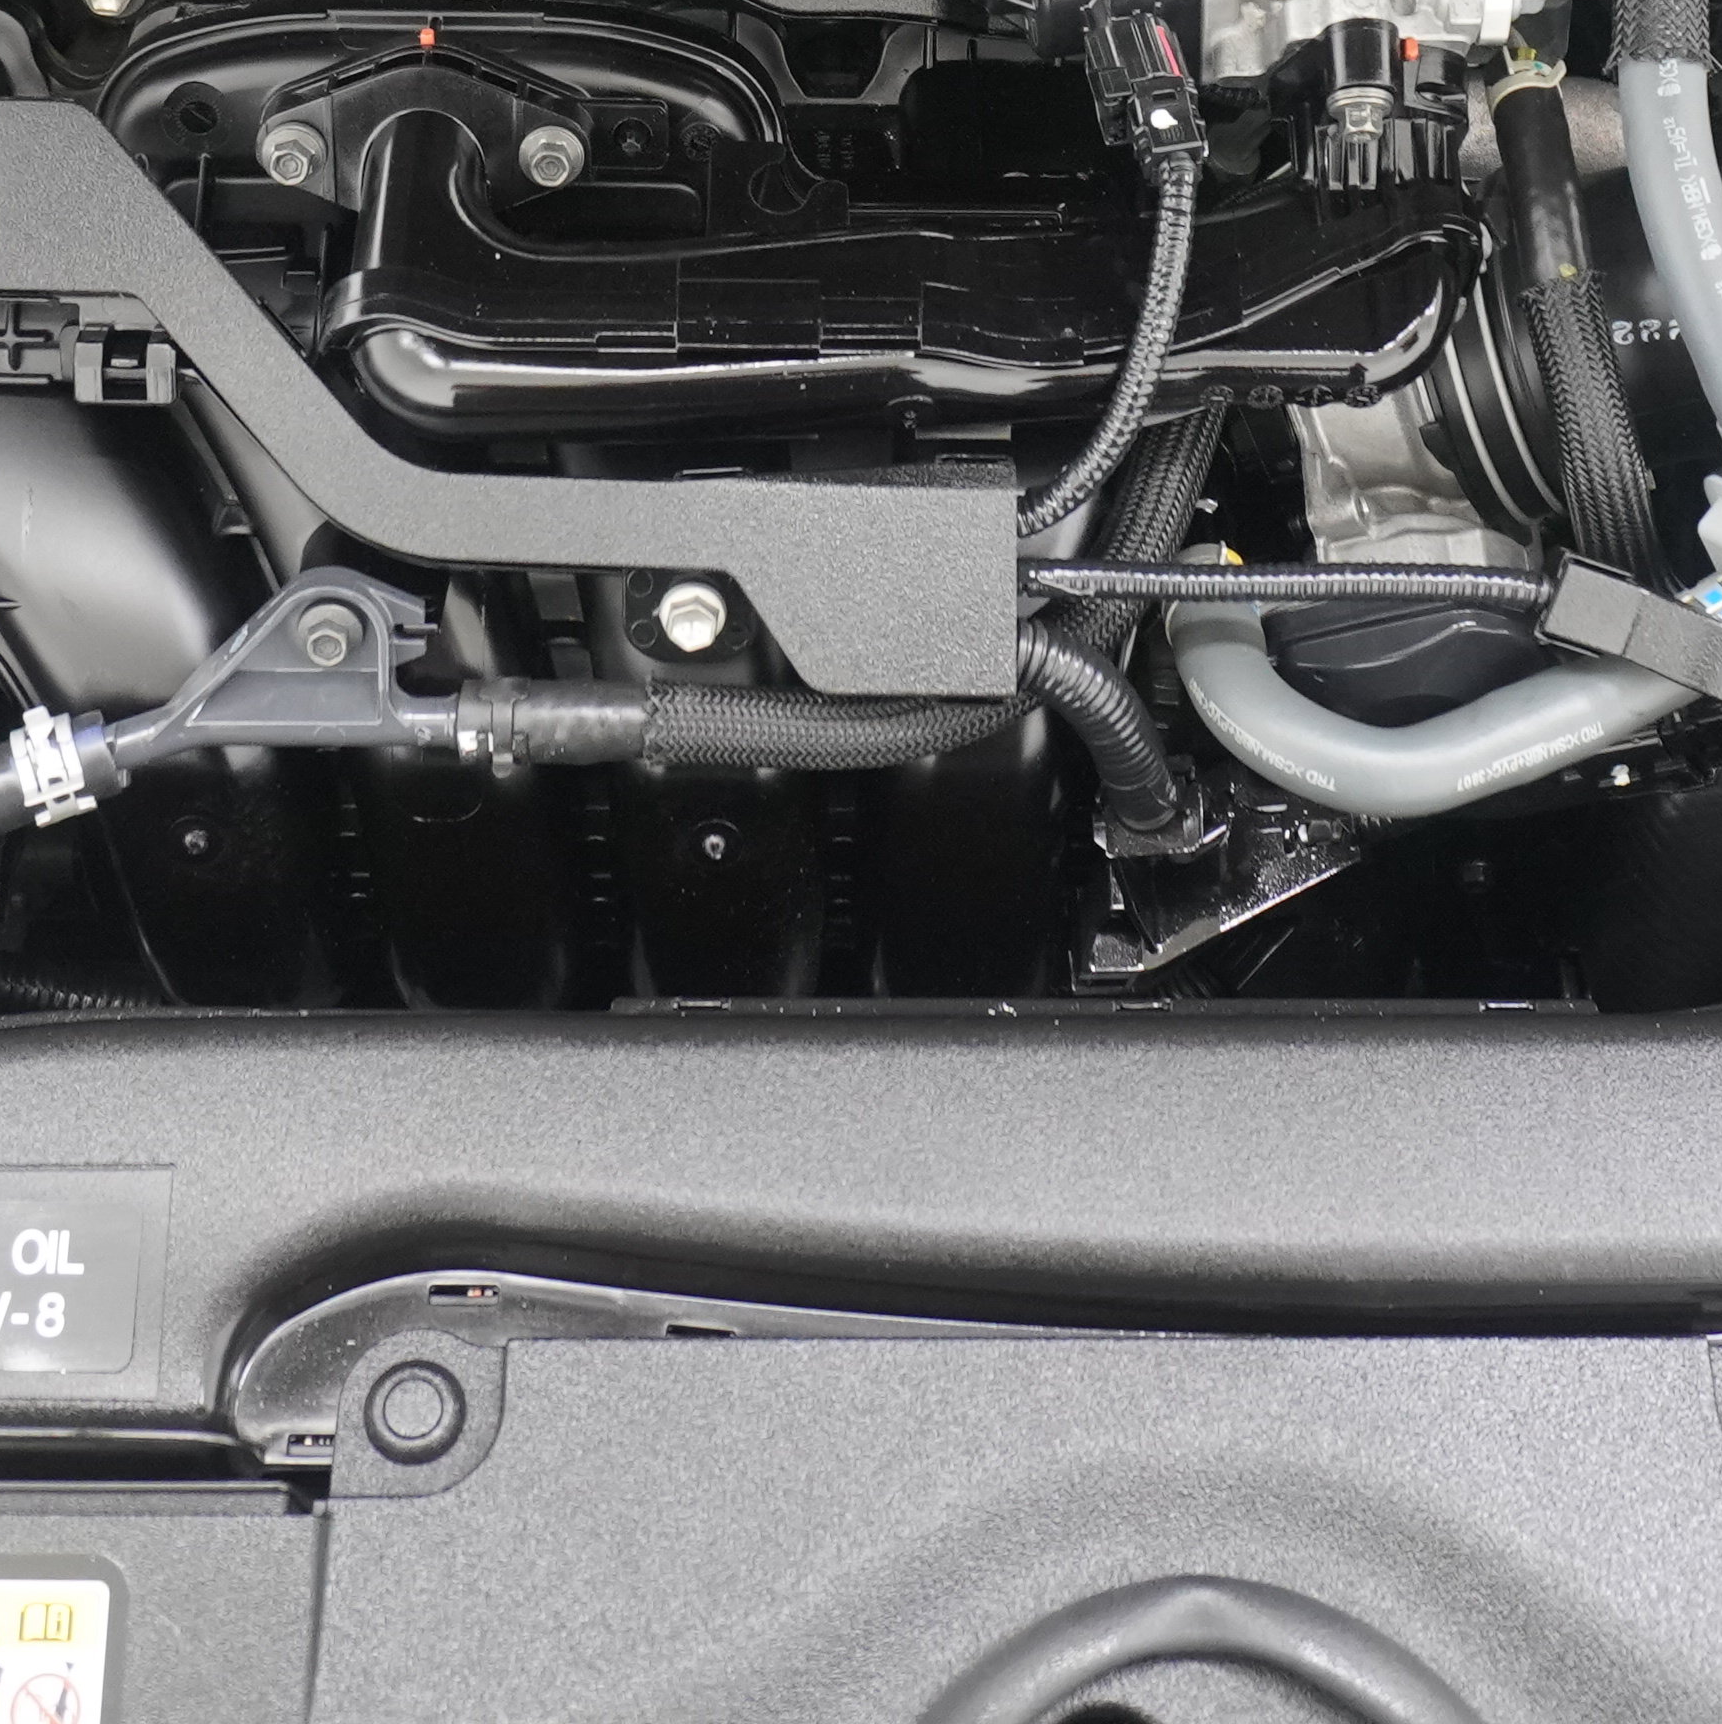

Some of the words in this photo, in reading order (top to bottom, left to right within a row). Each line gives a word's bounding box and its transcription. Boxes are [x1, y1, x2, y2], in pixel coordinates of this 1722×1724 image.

[1581, 720, 1604, 745] TRD
[1306, 769, 1338, 792] TRD
[11, 1228, 85, 1275] OIL
